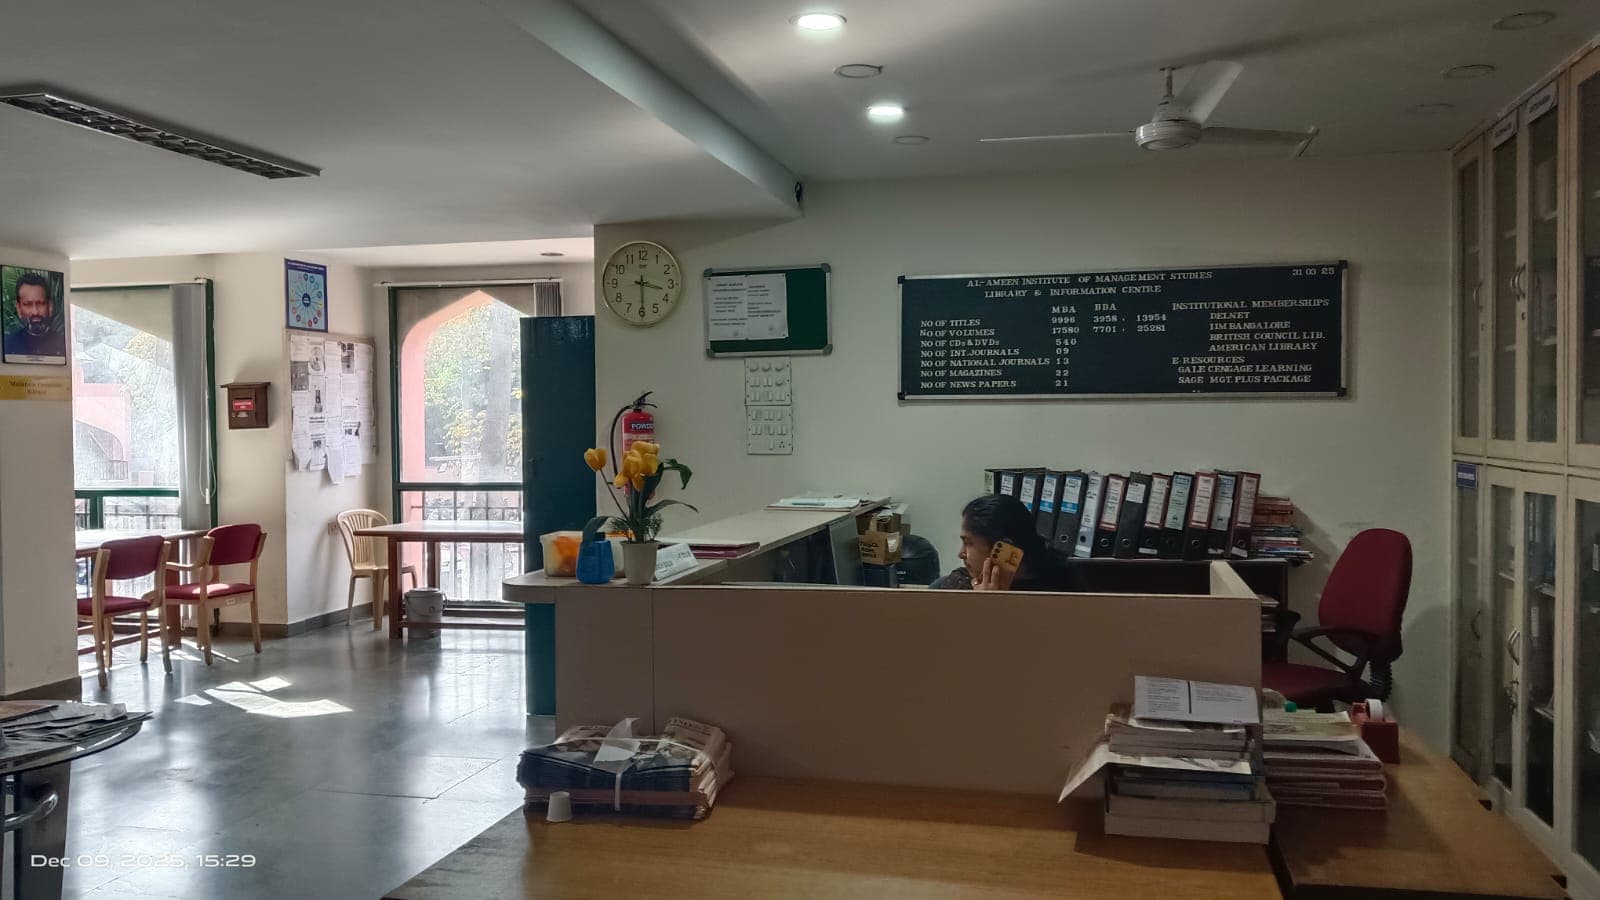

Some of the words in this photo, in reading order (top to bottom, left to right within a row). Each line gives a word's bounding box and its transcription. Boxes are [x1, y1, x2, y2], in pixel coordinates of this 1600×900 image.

[626, 254, 634, 264] 11
[639, 250, 648, 260] 12
[615, 264, 625, 275] 10
[663, 264, 670, 274] 2
[1292, 268, 1302, 276] 31
[1321, 267, 1335, 275] 25
[611, 278, 618, 289] 9
[667, 279, 674, 289] 3
[966, 277, 1019, 287] AL-AMEEN
[1022, 277, 1071, 285] INSTITUTE
[1078, 275, 1091, 283] OF
[1095, 273, 1166, 283] MANAGEMENT
[1169, 271, 1213, 280] STUDIES
[985, 289, 1027, 298] LIBRARY
[1050, 287, 1117, 297] INFORMATION
[1121, 285, 1162, 294] CENTRE
[615, 292, 622, 303] 8
[662, 293, 669, 303] 4
[626, 303, 632, 313] 7
[652, 303, 659, 313] 5
[1051, 306, 1077, 314] MBA
[1094, 303, 1117, 311] BBA
[1171, 301, 1247, 310] INSTITUTIONAL
[1251, 299, 1330, 308] MEMBERSHIPS
[639, 307, 645, 317] 6
[1209, 311, 1251, 320] DELNET
[920, 320, 933, 328] NO
[949, 319, 981, 327] TITLES
[1051, 316, 1076, 324] 9996
[1093, 315, 1118, 323] 3958
[1136, 313, 1167, 322] 13954
[1229, 321, 1291, 330] BANGALORE
[920, 329, 933, 337] NO
[949, 328, 996, 337] VOLUMES
[1052, 326, 1080, 334] 17580
[1137, 324, 1166, 332] 25281
[1209, 333, 1251, 341] BRITISH
[1254, 332, 1301, 340] COUNCIL
[920, 340, 933, 348] NO
[934, 340, 947, 348] OF
[1056, 338, 1077, 346] 540
[1209, 344, 1266, 352] AMERICAN
[1268, 342, 1318, 351] LIBRARY
[920, 350, 933, 358] NO
[934, 350, 947, 358] OF
[1056, 347, 1070, 355] 09
[920, 360, 933, 368] NO
[950, 358, 997, 367] NATIONAL
[998, 357, 1050, 366] JOURNALS
[949, 369, 1002, 377] MAGAZINES
[1055, 369, 1069, 377] 22
[1178, 365, 1206, 374] GALE
[1207, 365, 1254, 373] CENGAGE
[1255, 364, 1312, 372] LEARNING
[920, 381, 933, 389] NO
[934, 381, 947, 389] OF
[949, 380, 977, 389] NEWS
[978, 380, 1017, 388] PAPERS
[1055, 379, 1068, 387] 21
[1178, 376, 1204, 384] SAGE
[1234, 375, 1261, 383] PLUS
[1263, 375, 1312, 383] PACKAGE
